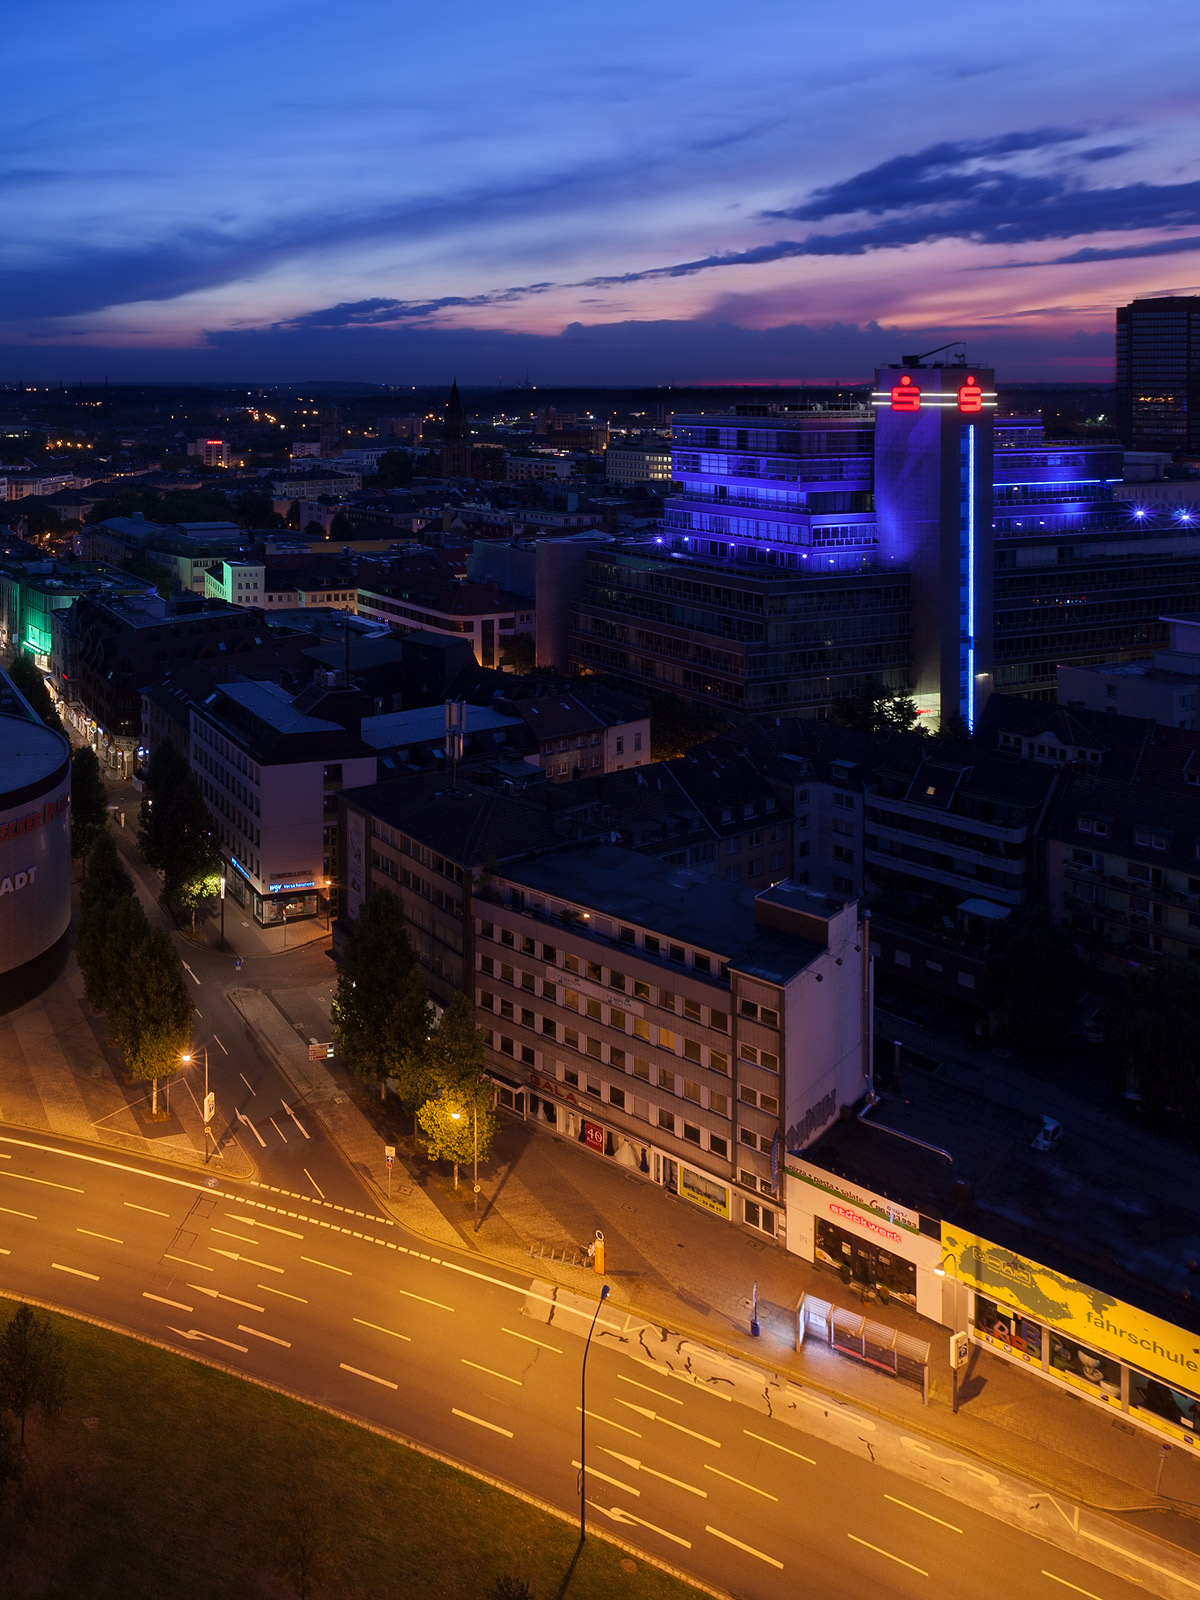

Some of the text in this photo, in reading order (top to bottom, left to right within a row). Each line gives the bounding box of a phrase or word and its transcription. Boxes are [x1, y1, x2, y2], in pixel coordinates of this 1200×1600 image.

[530, 1074, 577, 1104] GALA
[788, 1164, 864, 1204] pizza pasta salate
[829, 1204, 903, 1242] stückwerk
[1085, 1311, 1199, 1372] fahrschule
